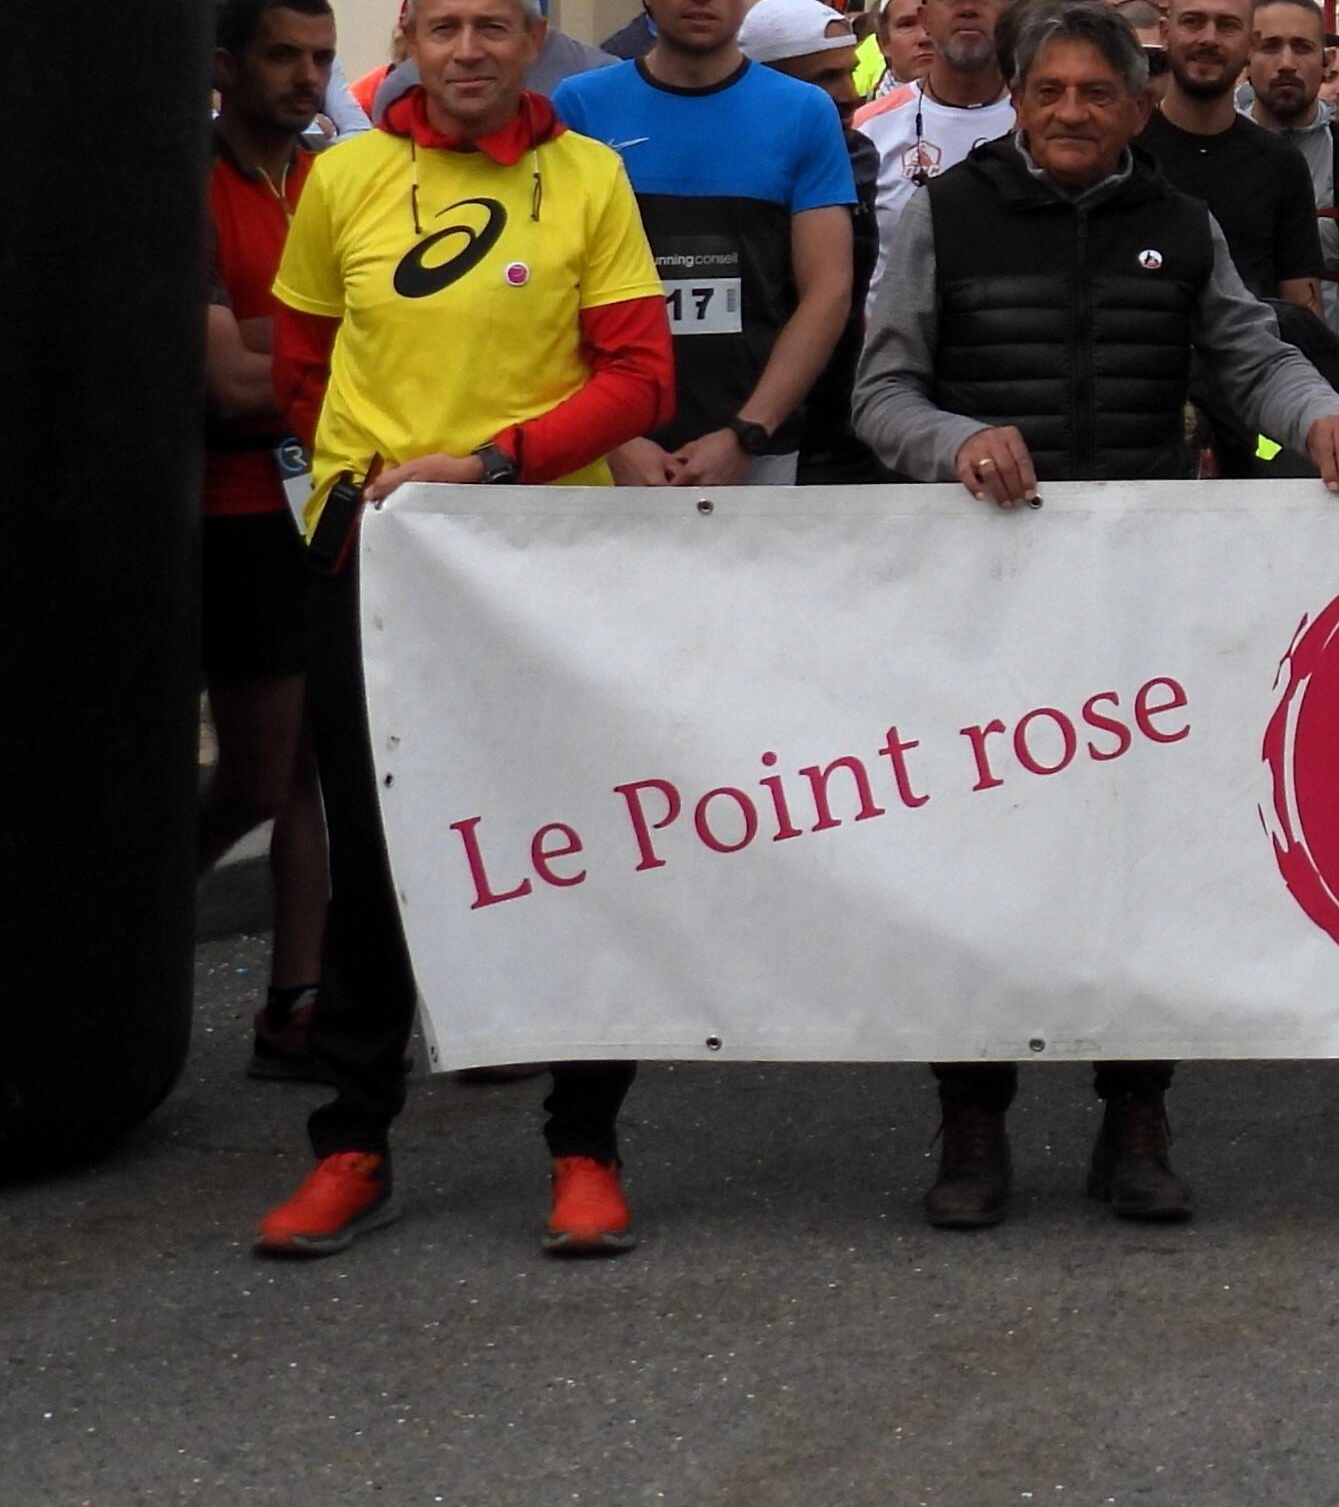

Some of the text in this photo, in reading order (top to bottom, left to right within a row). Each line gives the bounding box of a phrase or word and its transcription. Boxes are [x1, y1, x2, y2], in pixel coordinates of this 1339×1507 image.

[450, 676, 1192, 910] Le Point rose
